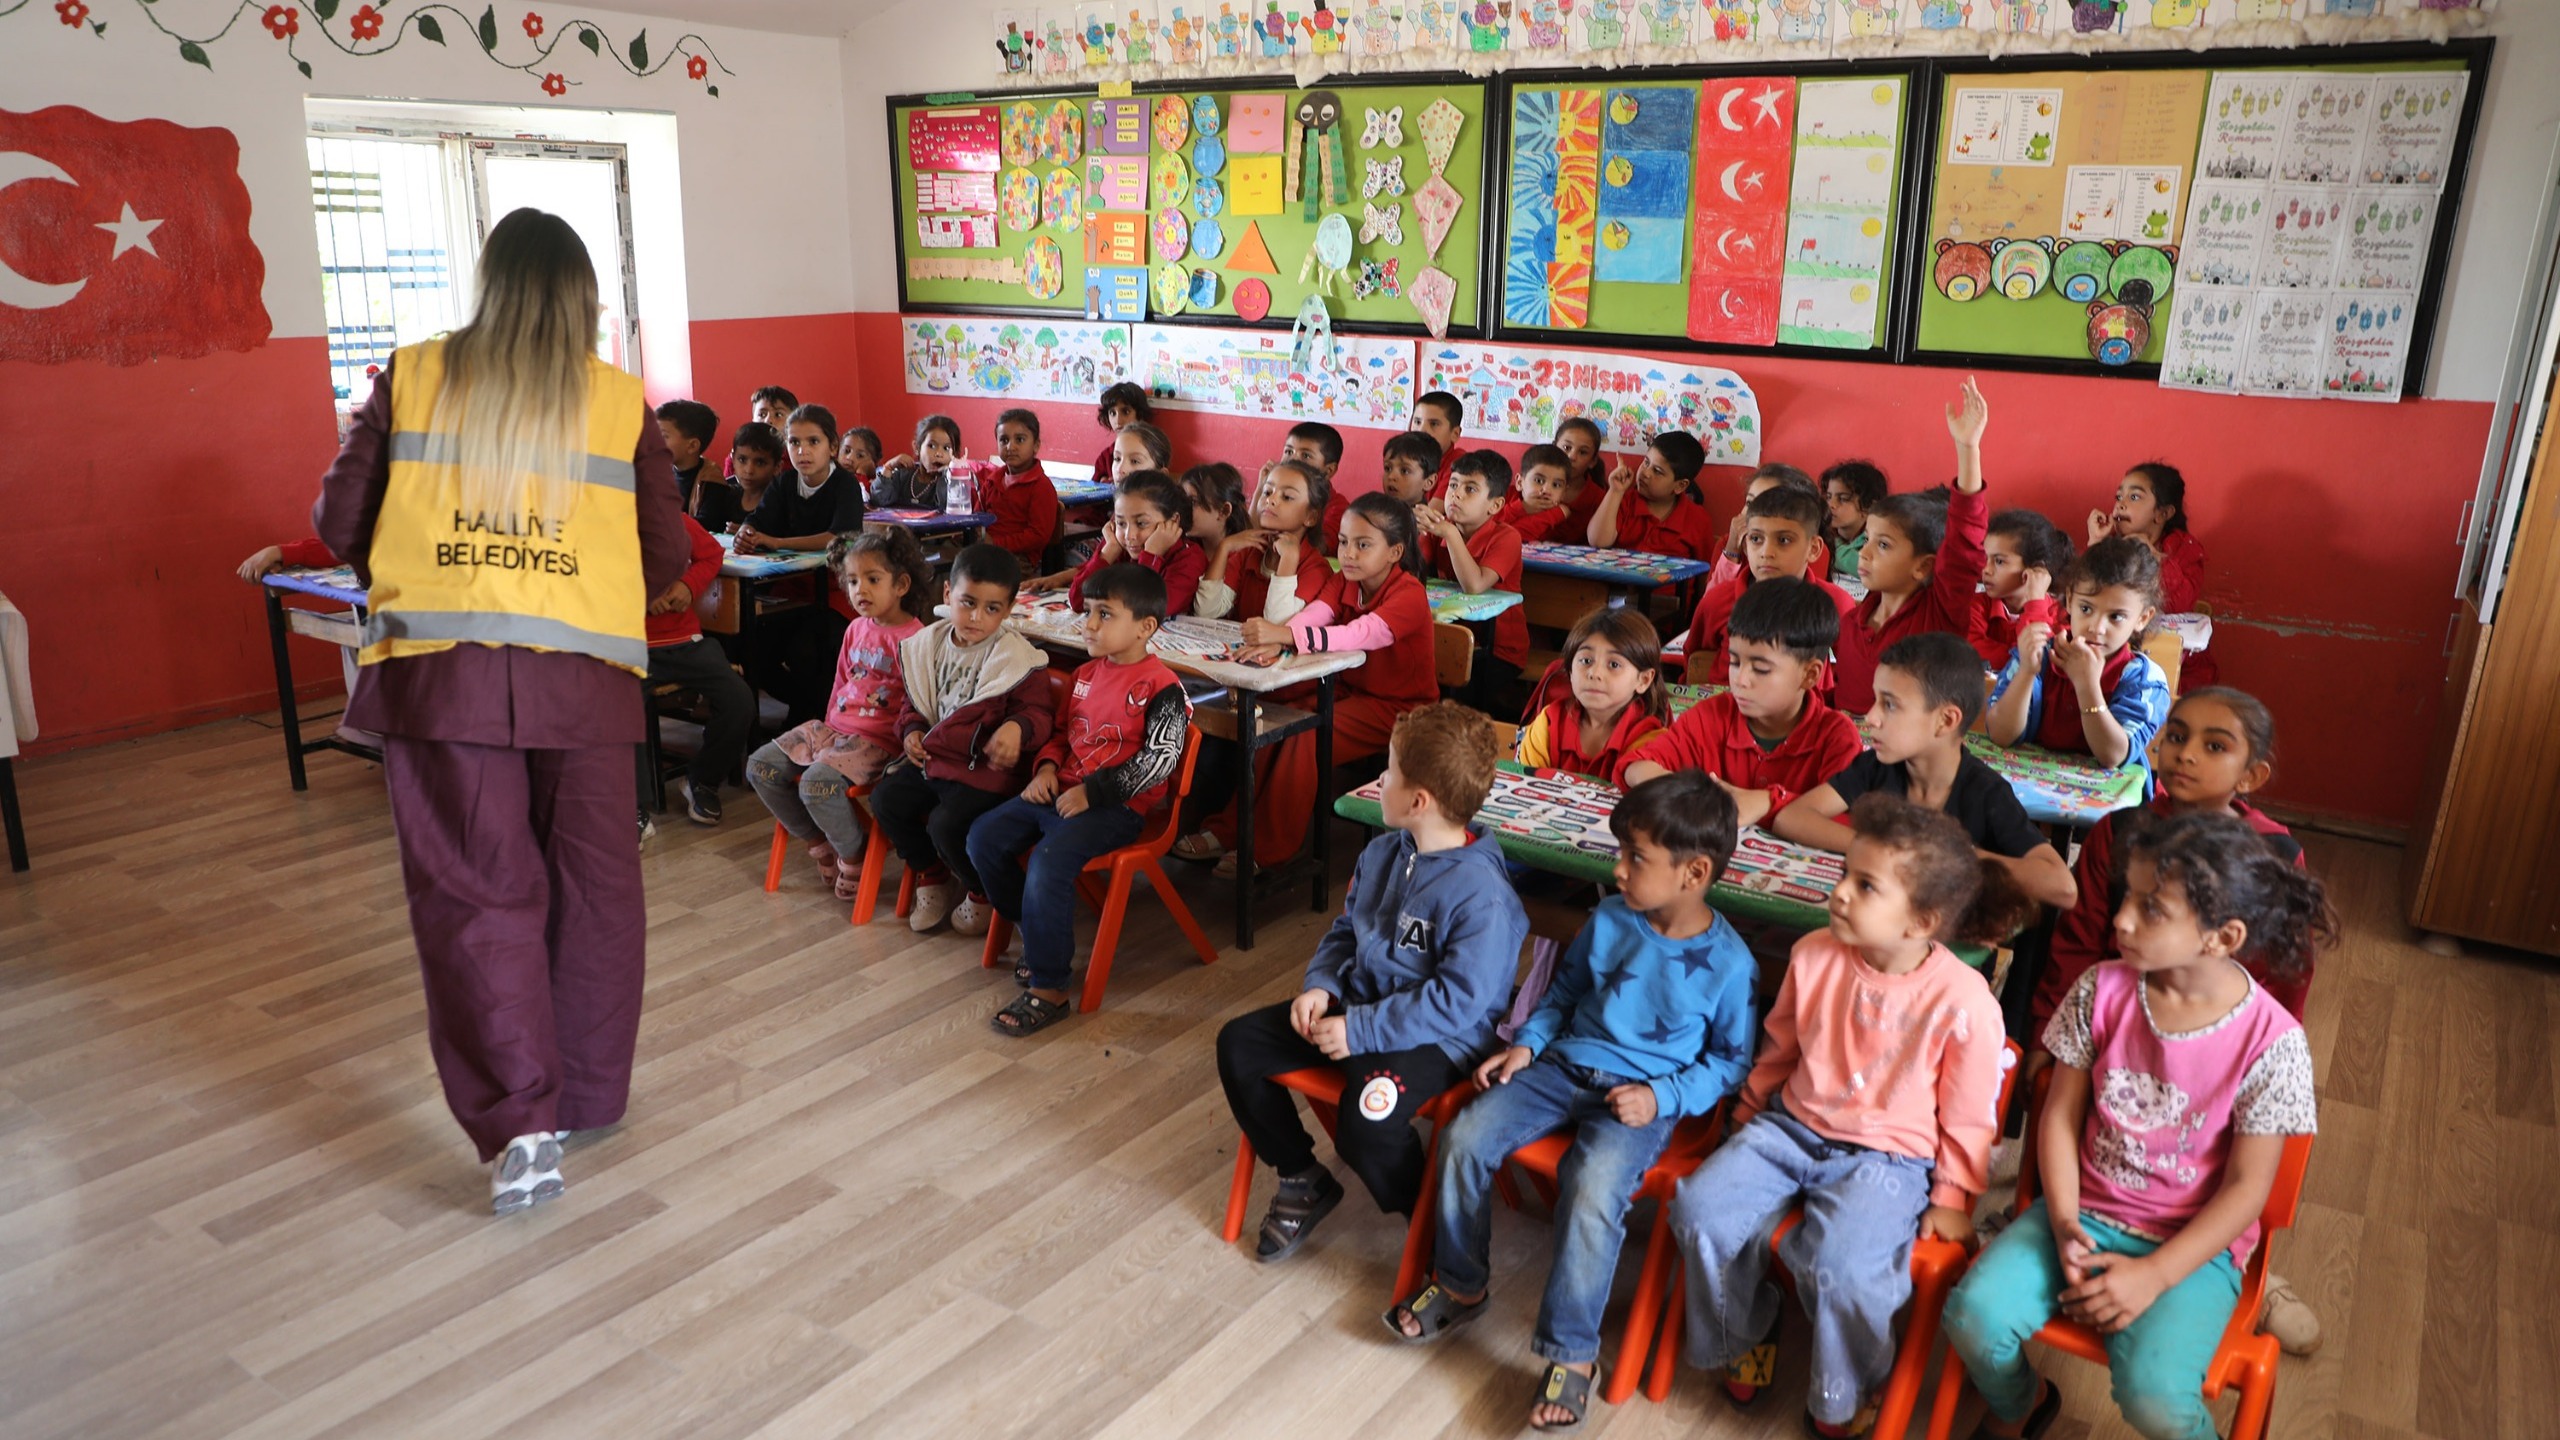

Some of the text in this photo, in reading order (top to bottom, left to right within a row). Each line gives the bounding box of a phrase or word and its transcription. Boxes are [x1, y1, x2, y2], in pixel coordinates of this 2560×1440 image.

[2334, 346, 2390, 358] Ramazan
[1533, 358, 1643, 394] 23 Nisan
[437, 540, 579, 576] BELEDİYESİ
